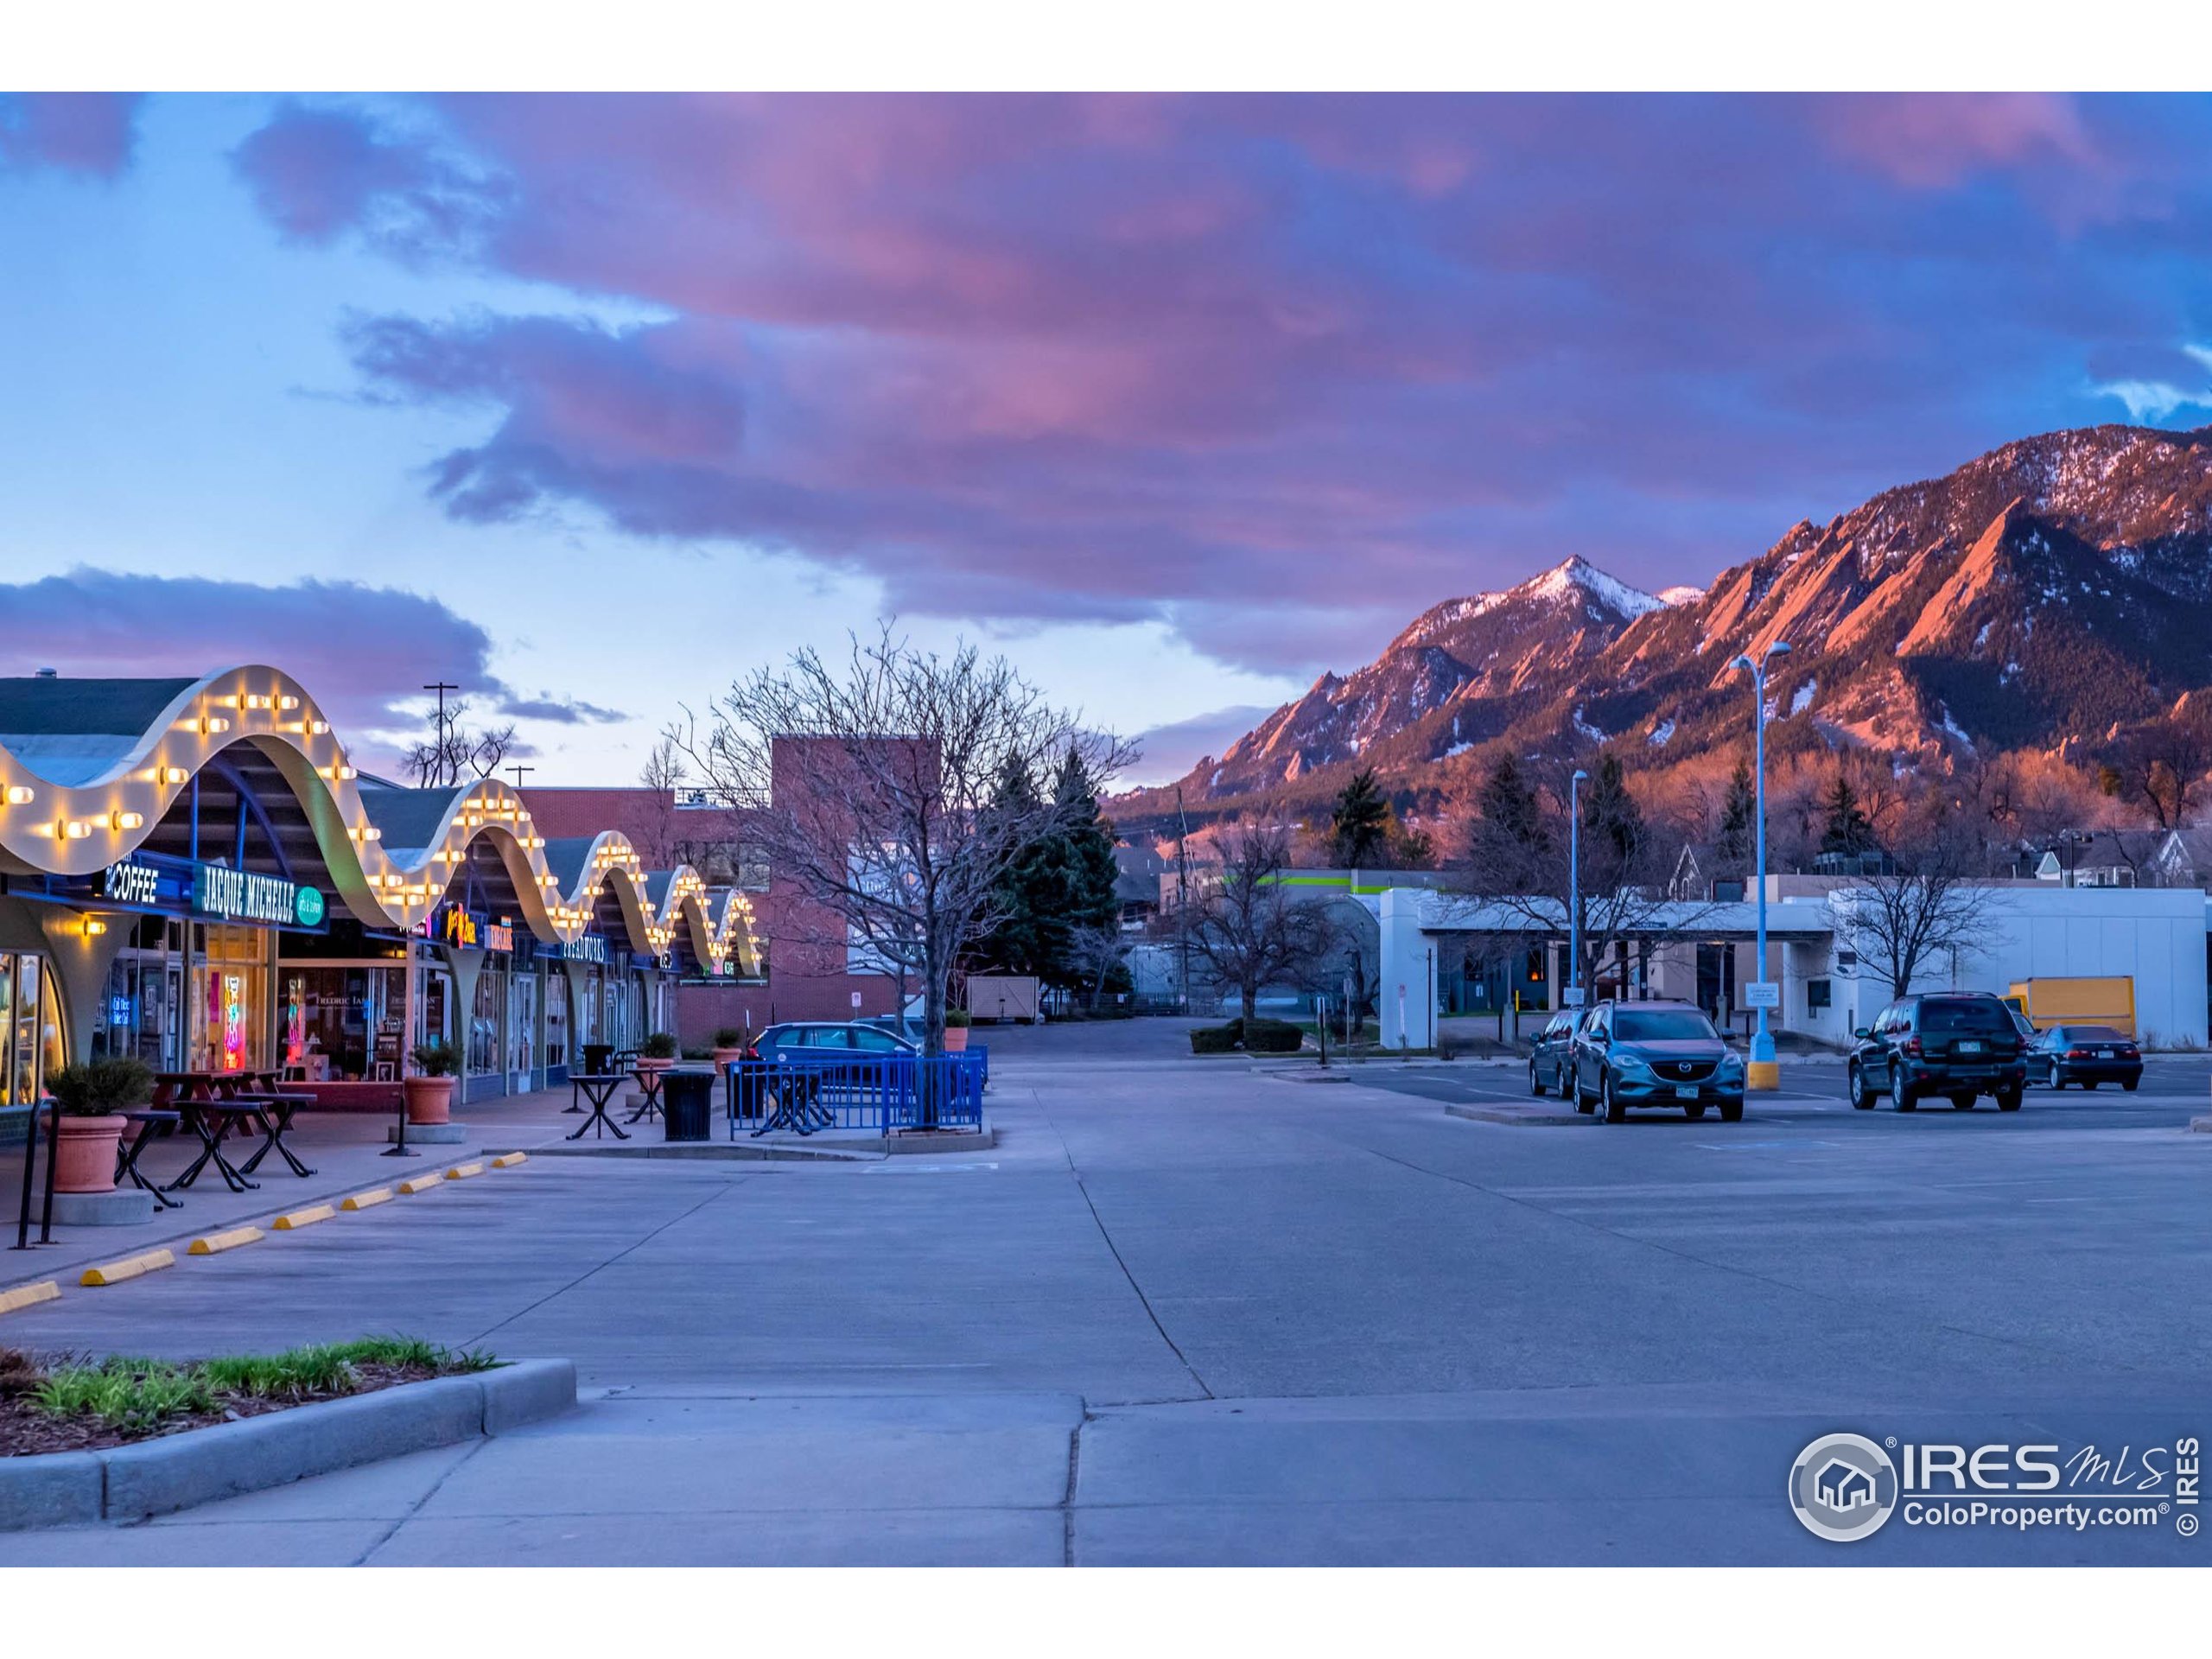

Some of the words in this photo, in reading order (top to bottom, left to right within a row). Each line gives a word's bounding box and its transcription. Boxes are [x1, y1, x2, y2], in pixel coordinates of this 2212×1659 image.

[113, 863, 158, 904] COFFEE
[202, 866, 243, 919] JACQUE
[245, 874, 295, 924] MICHELLE
